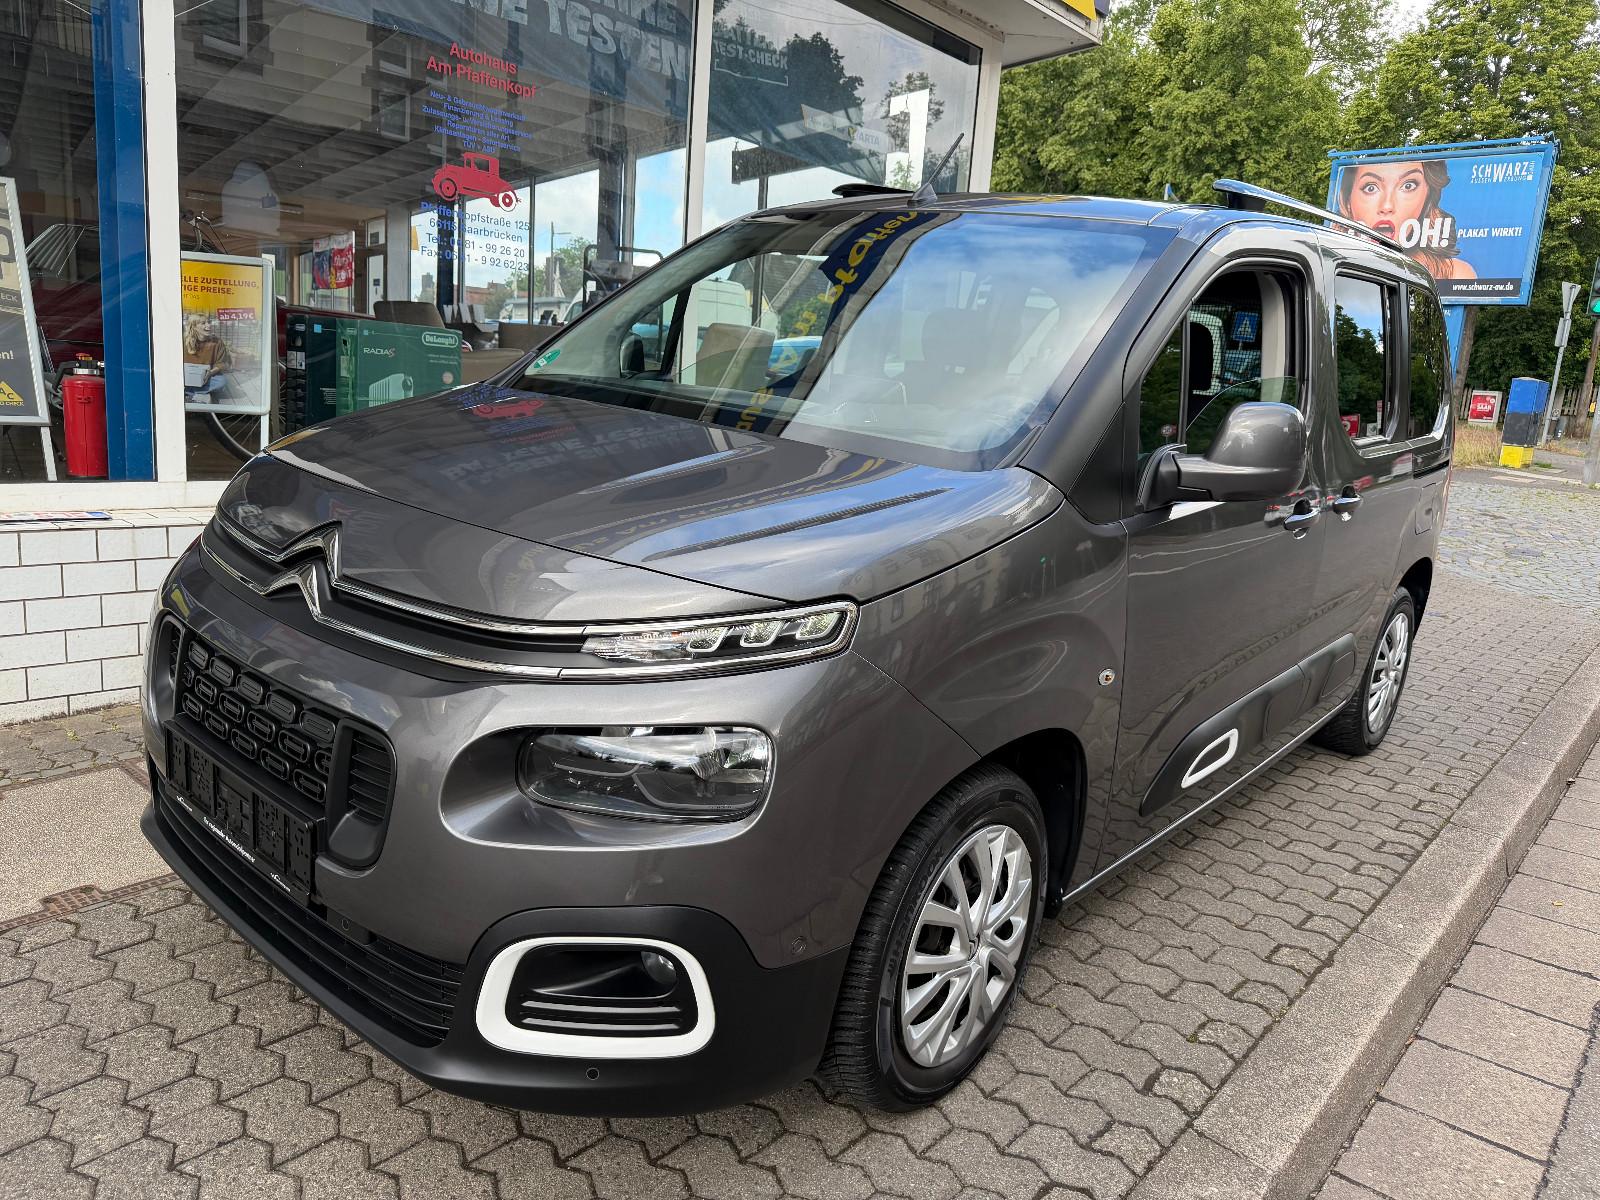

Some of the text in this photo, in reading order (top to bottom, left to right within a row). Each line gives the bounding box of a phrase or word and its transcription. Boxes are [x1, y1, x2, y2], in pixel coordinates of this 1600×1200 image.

[449, 41, 517, 75] Autohaus
[426, 56, 537, 98] Am Pfaffenkopf
[1471, 161, 1529, 183] SCHWARZ
[429, 217, 523, 243] 66115 Saarbrücken
[514, 220, 530, 231] 125
[1400, 217, 1452, 249] OH!
[1457, 226, 1523, 238] PLAKAT WIRKT!
[485, 243, 497, 254] 99
[500, 245, 512, 256] 26
[514, 247, 525, 258] 20
[481, 255, 487, 265] 9
[489, 257, 501, 267] 92
[503, 259, 515, 269] 62
[517, 261, 529, 272] 23
[181, 275, 260, 288] LLE ZUSTELLUNG,
[181, 284, 235, 295] IGE PREISE.
[1452, 281, 1514, 291] www.schwarz-aw.de
